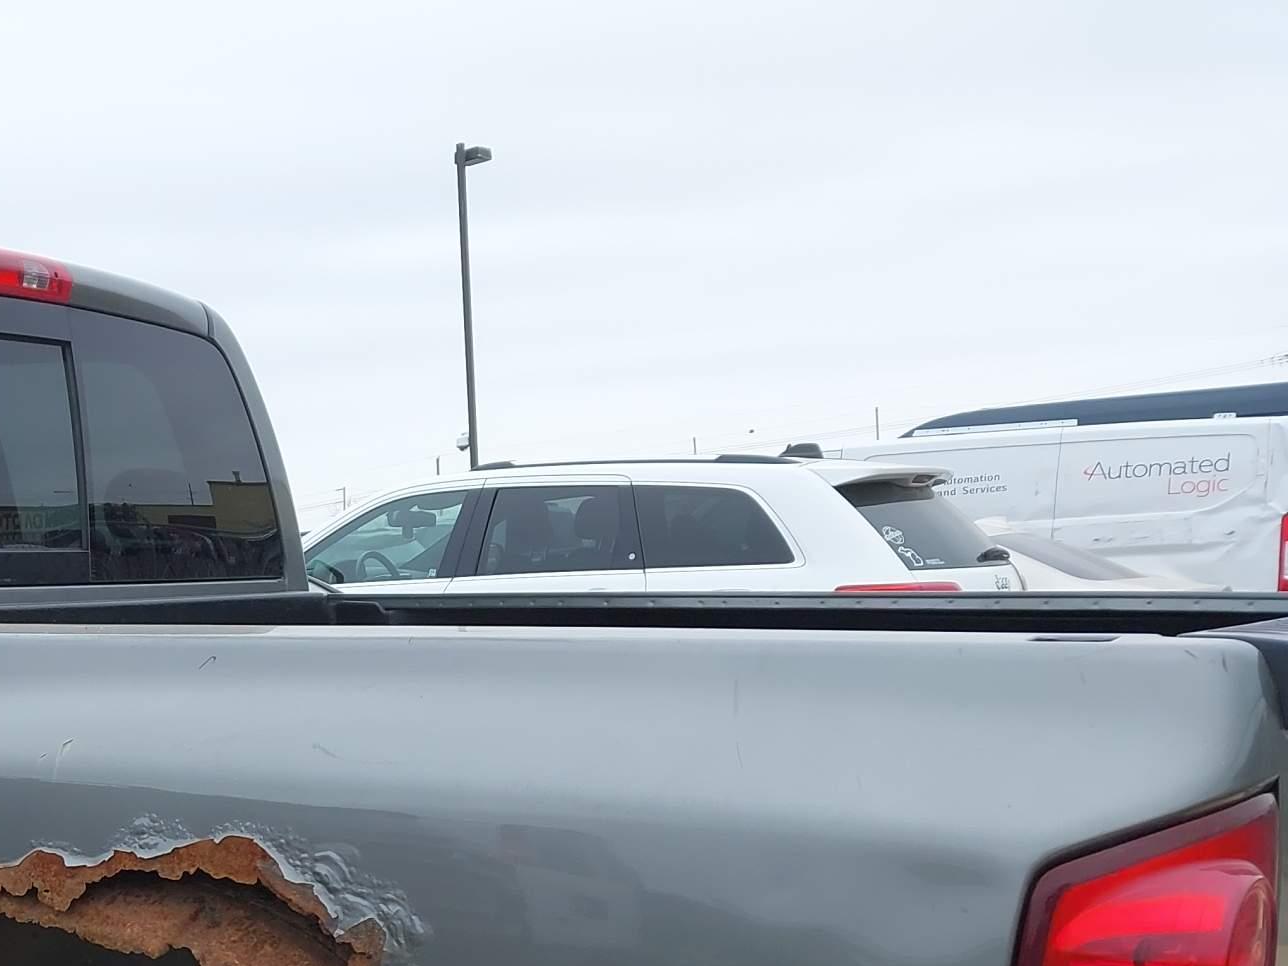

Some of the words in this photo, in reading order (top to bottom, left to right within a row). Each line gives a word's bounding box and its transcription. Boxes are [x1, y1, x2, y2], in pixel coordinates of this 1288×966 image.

[1087, 453, 1231, 481] Automated
[962, 484, 1008, 495] Services
[1167, 476, 1228, 497] Logic
